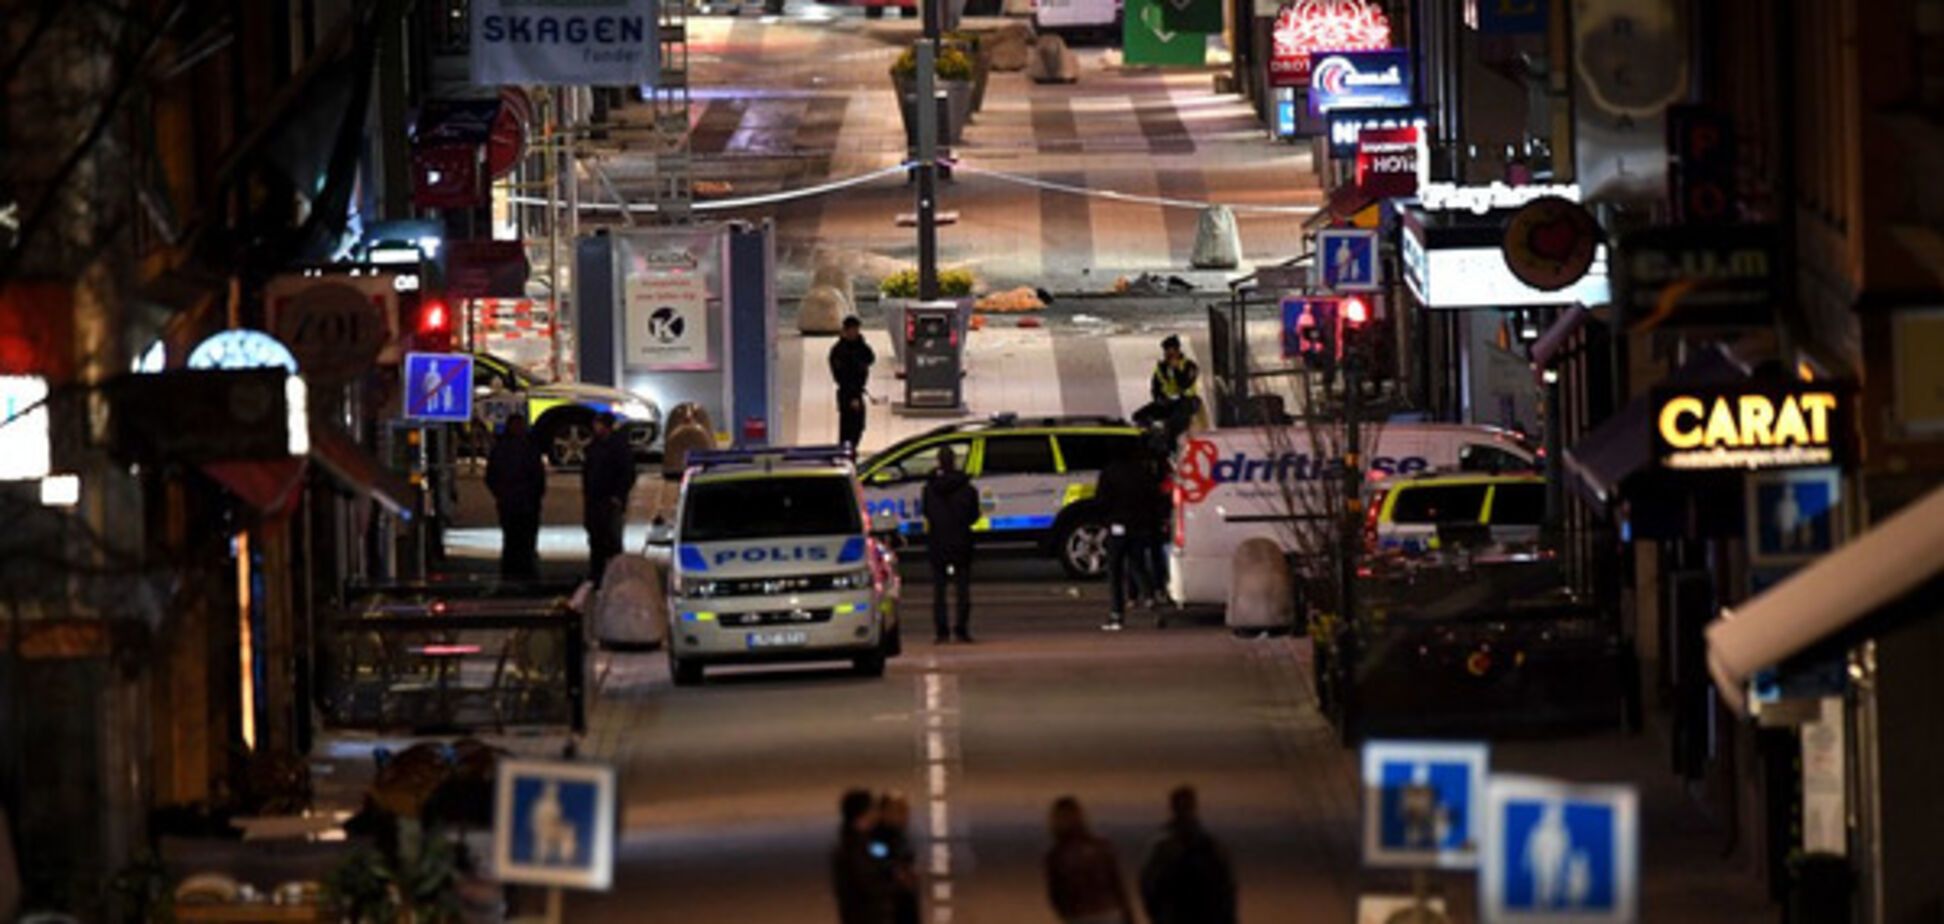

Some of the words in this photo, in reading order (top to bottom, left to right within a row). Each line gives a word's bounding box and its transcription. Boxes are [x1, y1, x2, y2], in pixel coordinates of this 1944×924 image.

[484, 15, 644, 43] SKAGEN
[1659, 392, 1836, 448] CARAT
[867, 498, 923, 519] POLI
[714, 547, 828, 565] POLIS
